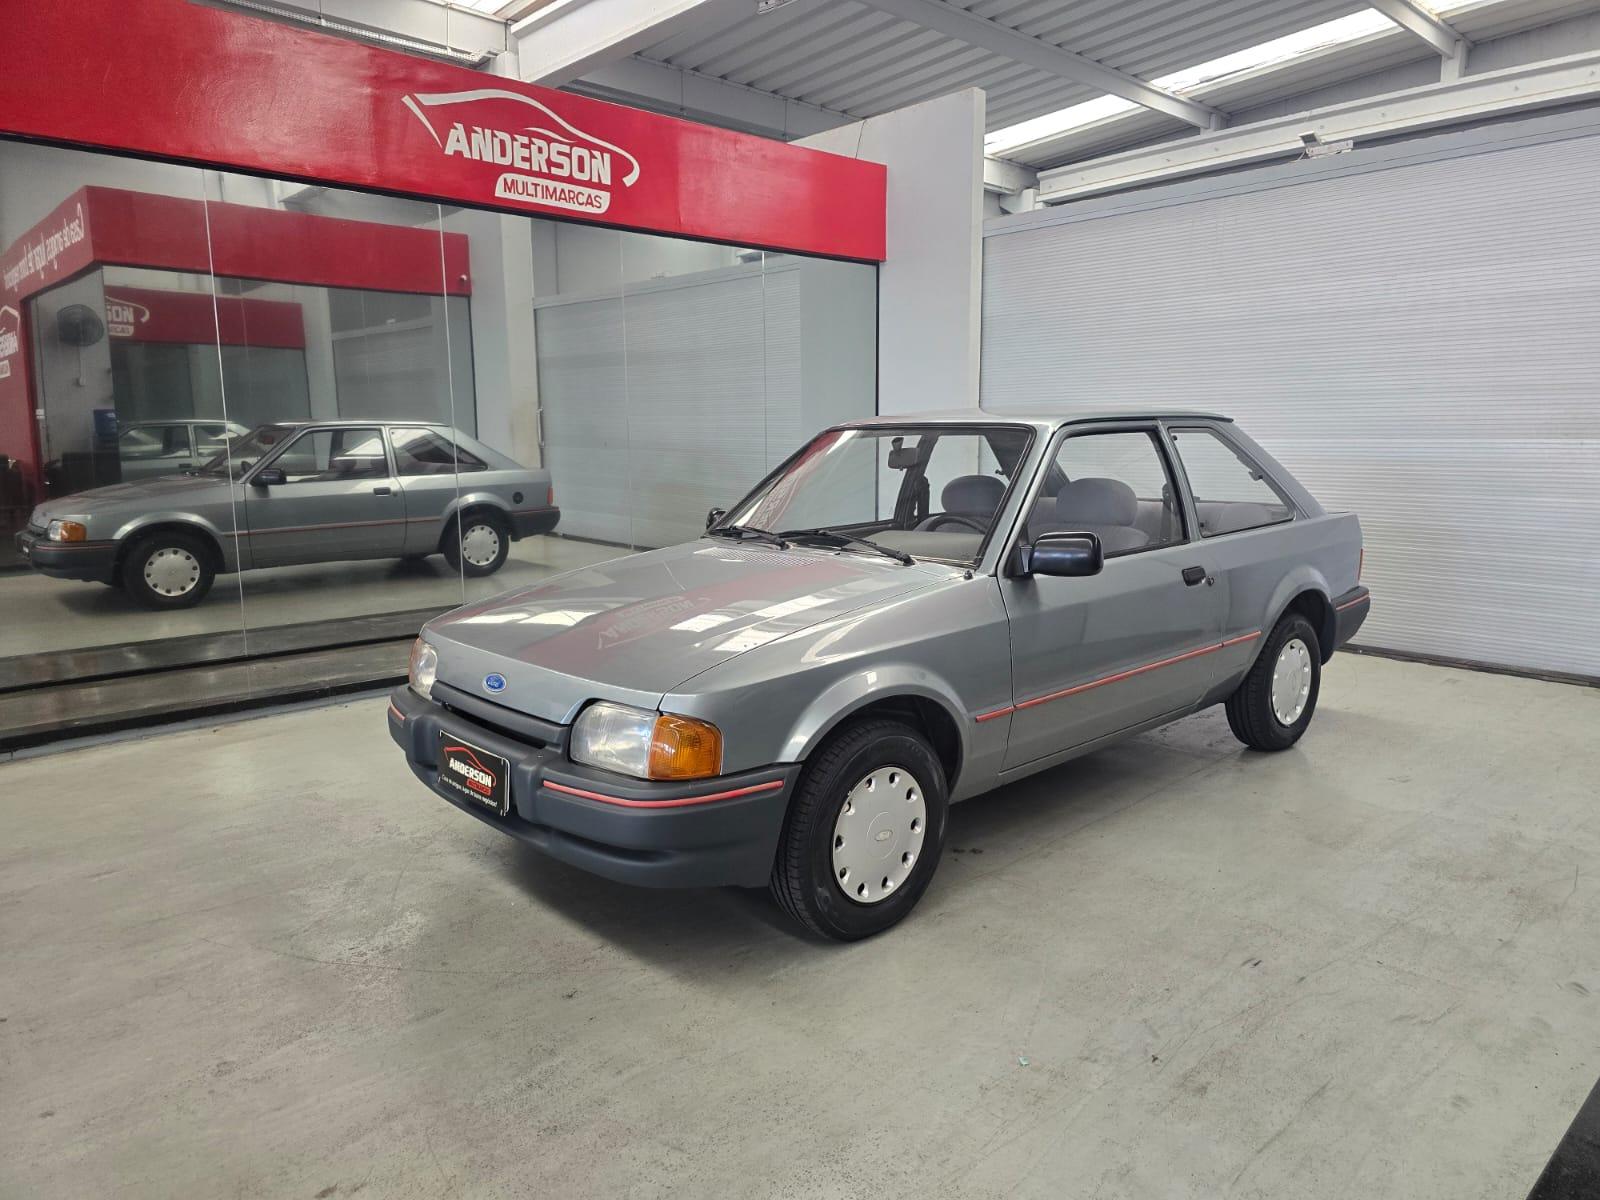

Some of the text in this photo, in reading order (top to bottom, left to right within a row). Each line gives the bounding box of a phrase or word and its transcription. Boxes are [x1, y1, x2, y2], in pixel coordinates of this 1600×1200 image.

[445, 122, 611, 185] ANDERSON
[503, 177, 602, 209] MULTIMARCAS
[449, 757, 492, 788] ANDERSON
